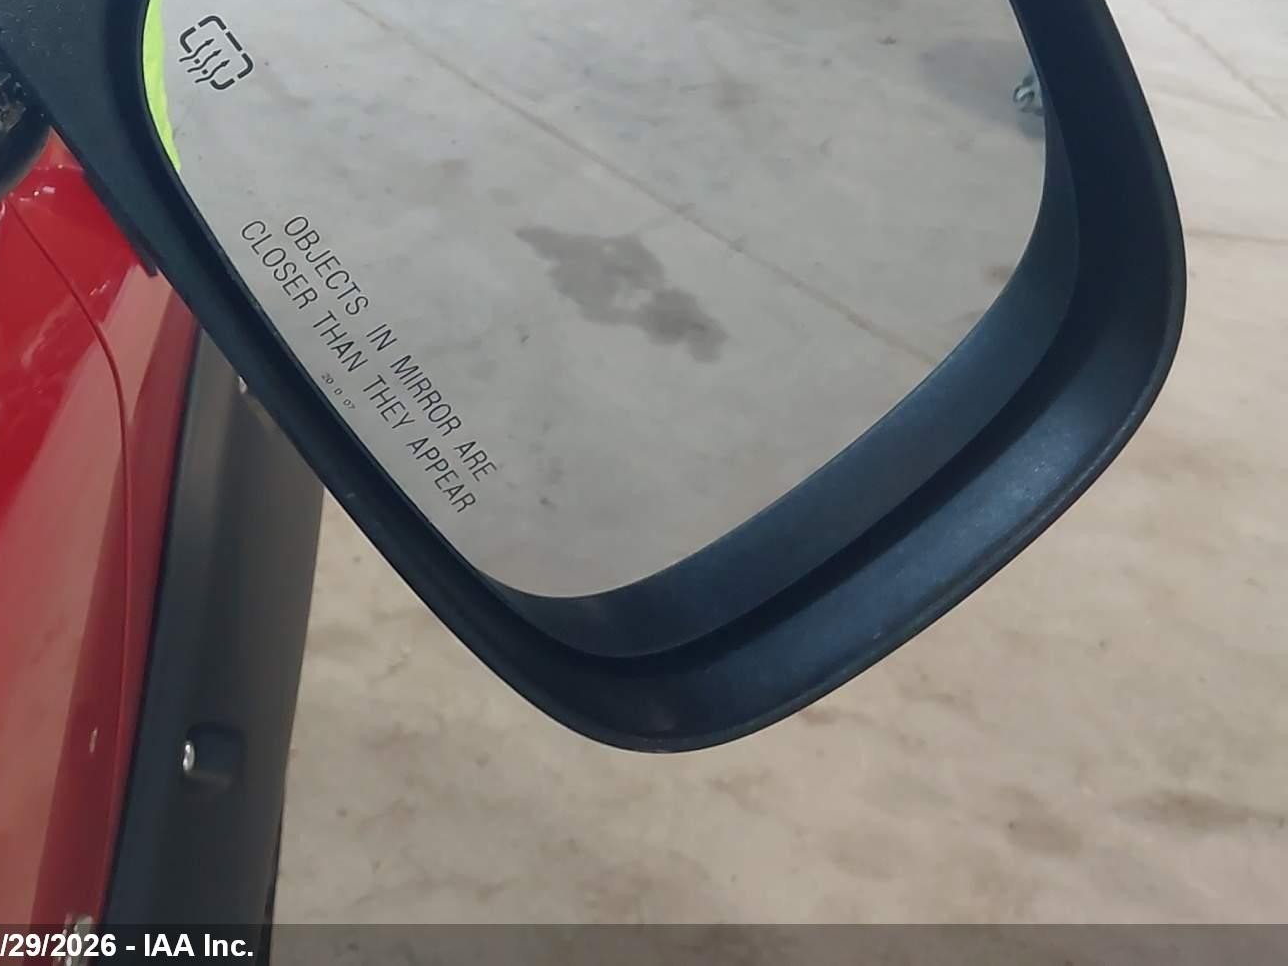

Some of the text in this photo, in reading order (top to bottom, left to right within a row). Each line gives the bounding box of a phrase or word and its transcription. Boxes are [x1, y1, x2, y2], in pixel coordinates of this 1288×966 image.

[241, 220, 476, 513] CLOSER THAN THEY APPEAR
[284, 216, 497, 482] OBJECTS IN MIRROR ARE
